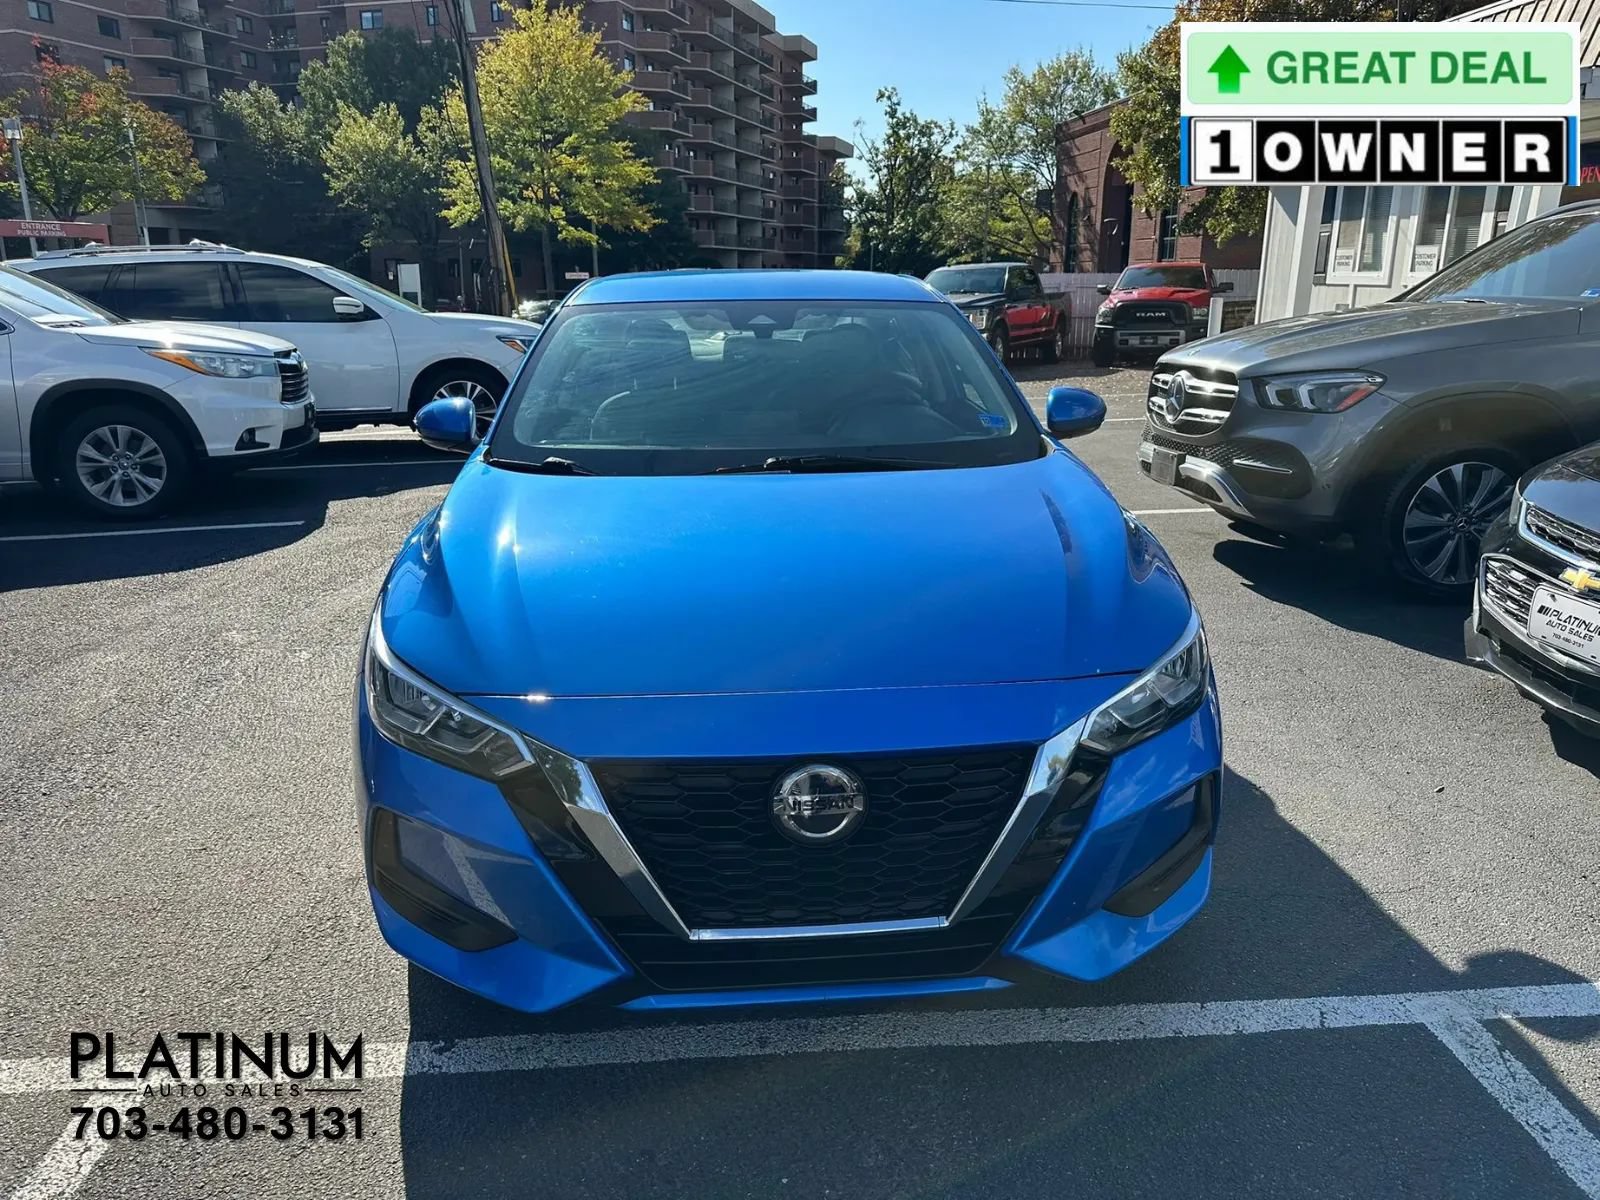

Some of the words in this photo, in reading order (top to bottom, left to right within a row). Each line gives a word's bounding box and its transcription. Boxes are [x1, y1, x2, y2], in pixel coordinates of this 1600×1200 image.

[1580, 166, 1600, 184] PEN
[21, 222, 61, 231] ENTRANCE
[1546, 619, 1567, 632] AUTO
[1568, 627, 1594, 642] SALES
[788, 796, 854, 813] NISSAN
